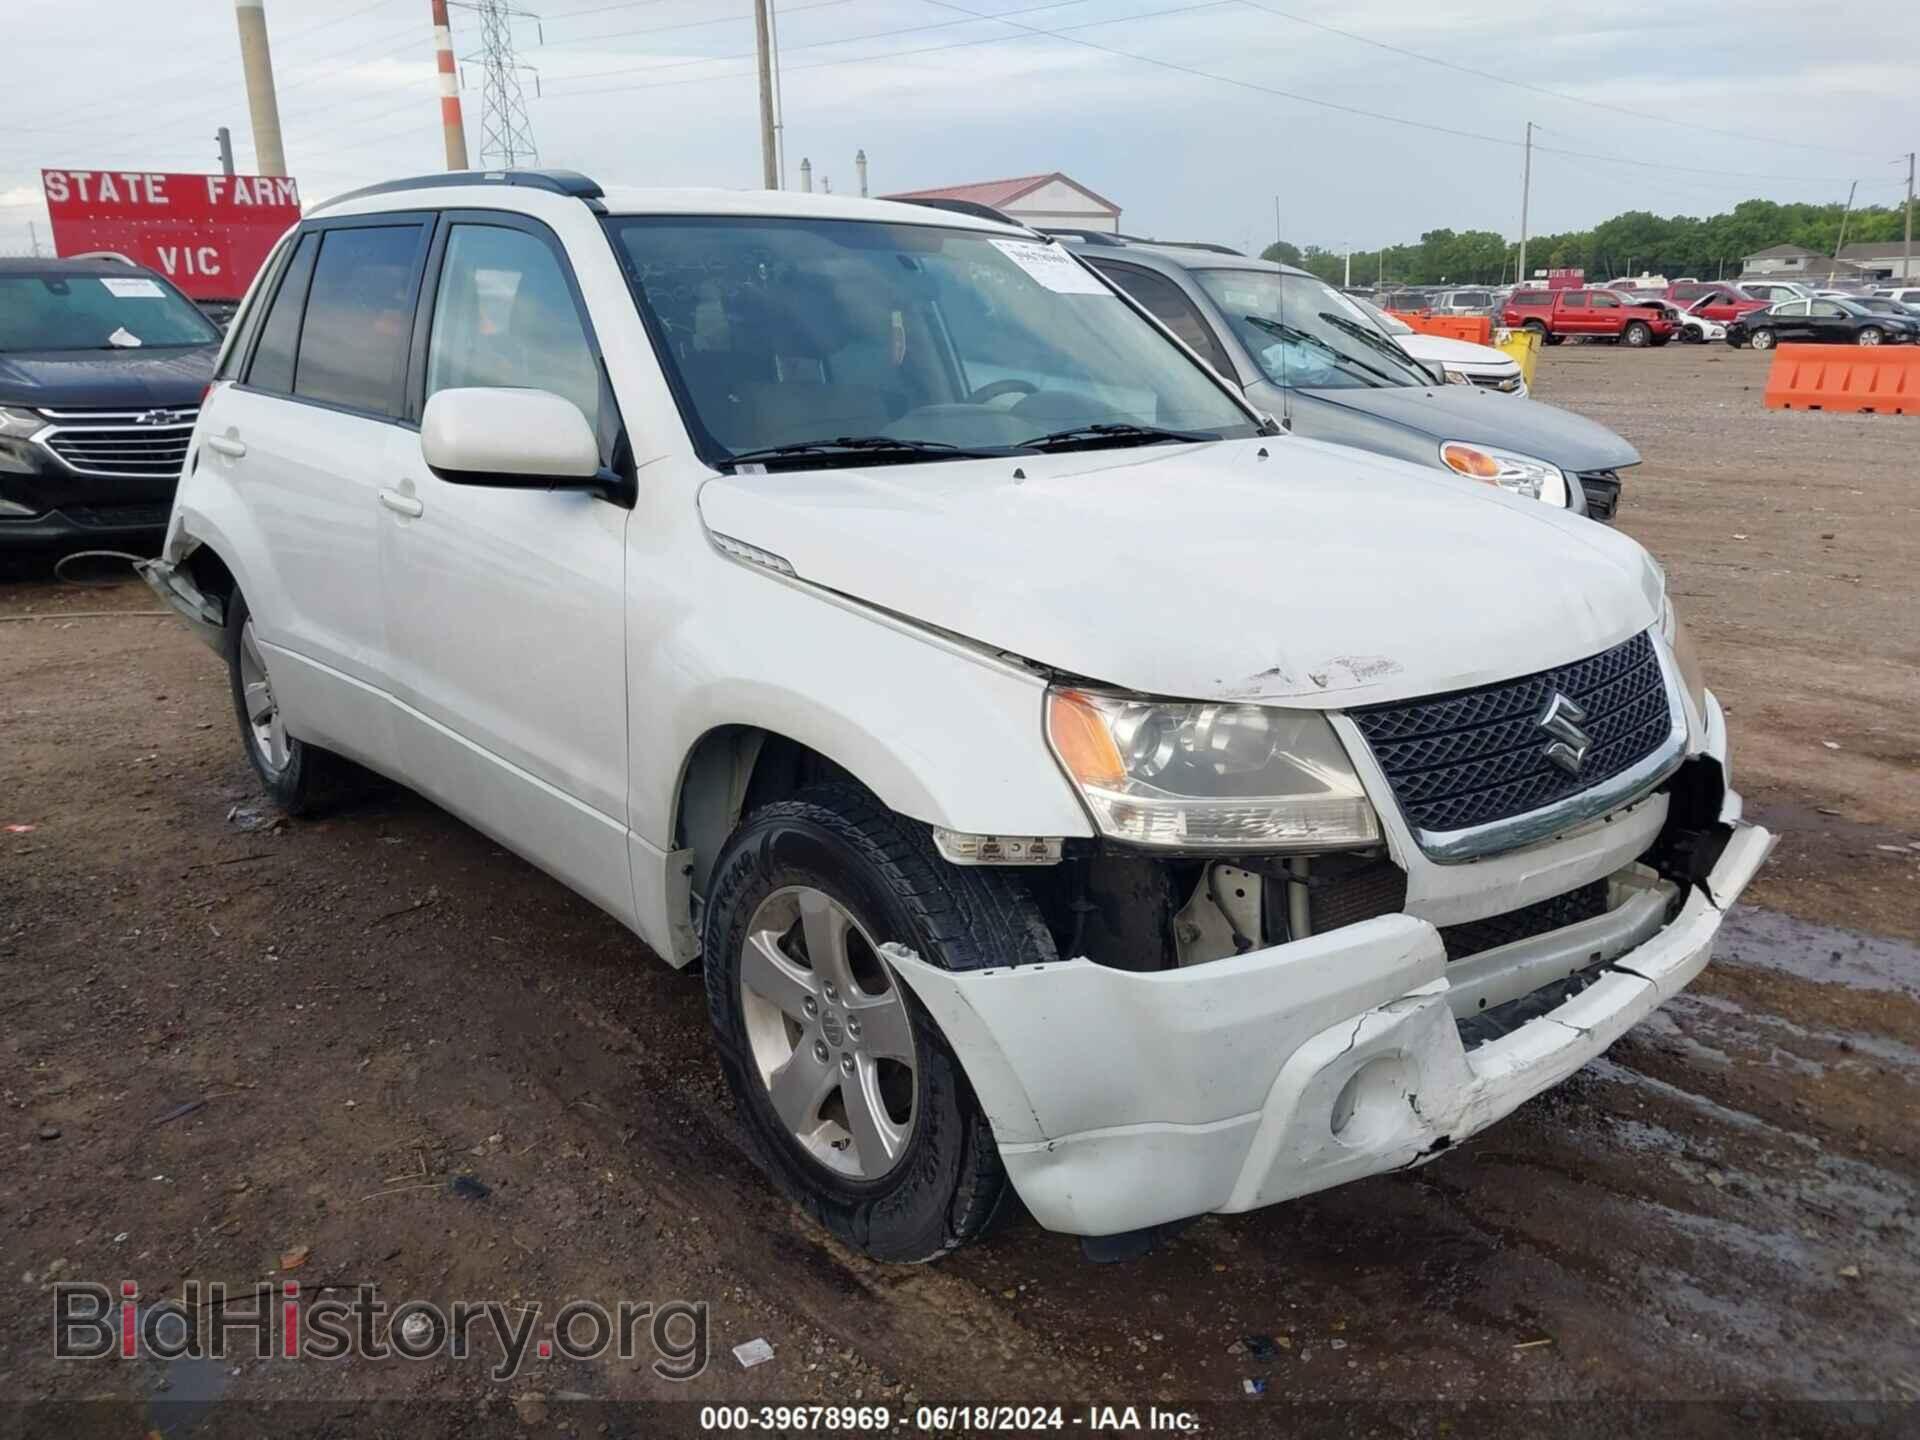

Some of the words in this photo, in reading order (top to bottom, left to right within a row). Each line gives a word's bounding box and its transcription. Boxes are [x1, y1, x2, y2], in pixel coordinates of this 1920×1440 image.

[44, 171, 169, 203] STATE
[206, 176, 299, 207] FARM
[156, 246, 221, 276] VIC
